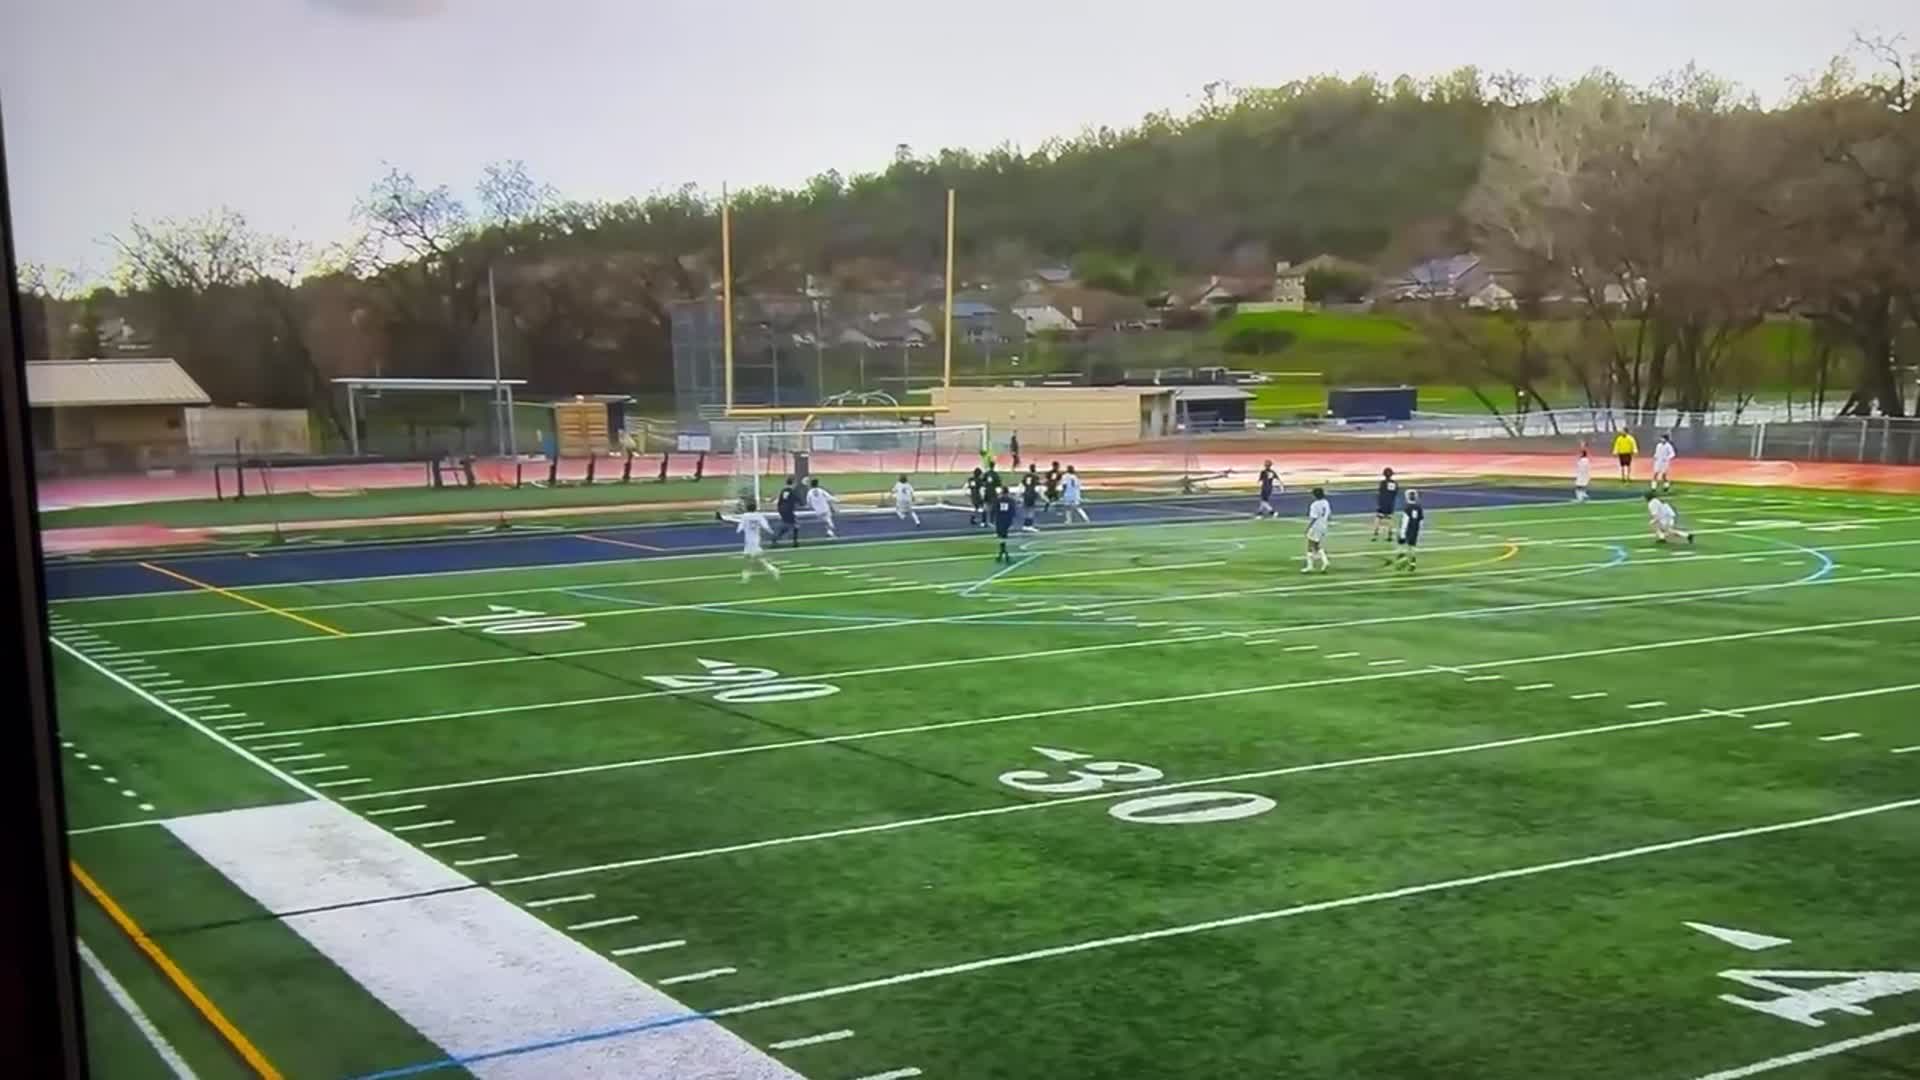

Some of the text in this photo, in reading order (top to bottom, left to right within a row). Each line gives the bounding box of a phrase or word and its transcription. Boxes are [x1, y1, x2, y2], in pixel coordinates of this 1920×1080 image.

[437, 608, 587, 634] 10
[641, 666, 841, 703] 20
[998, 761, 1277, 824] 30
